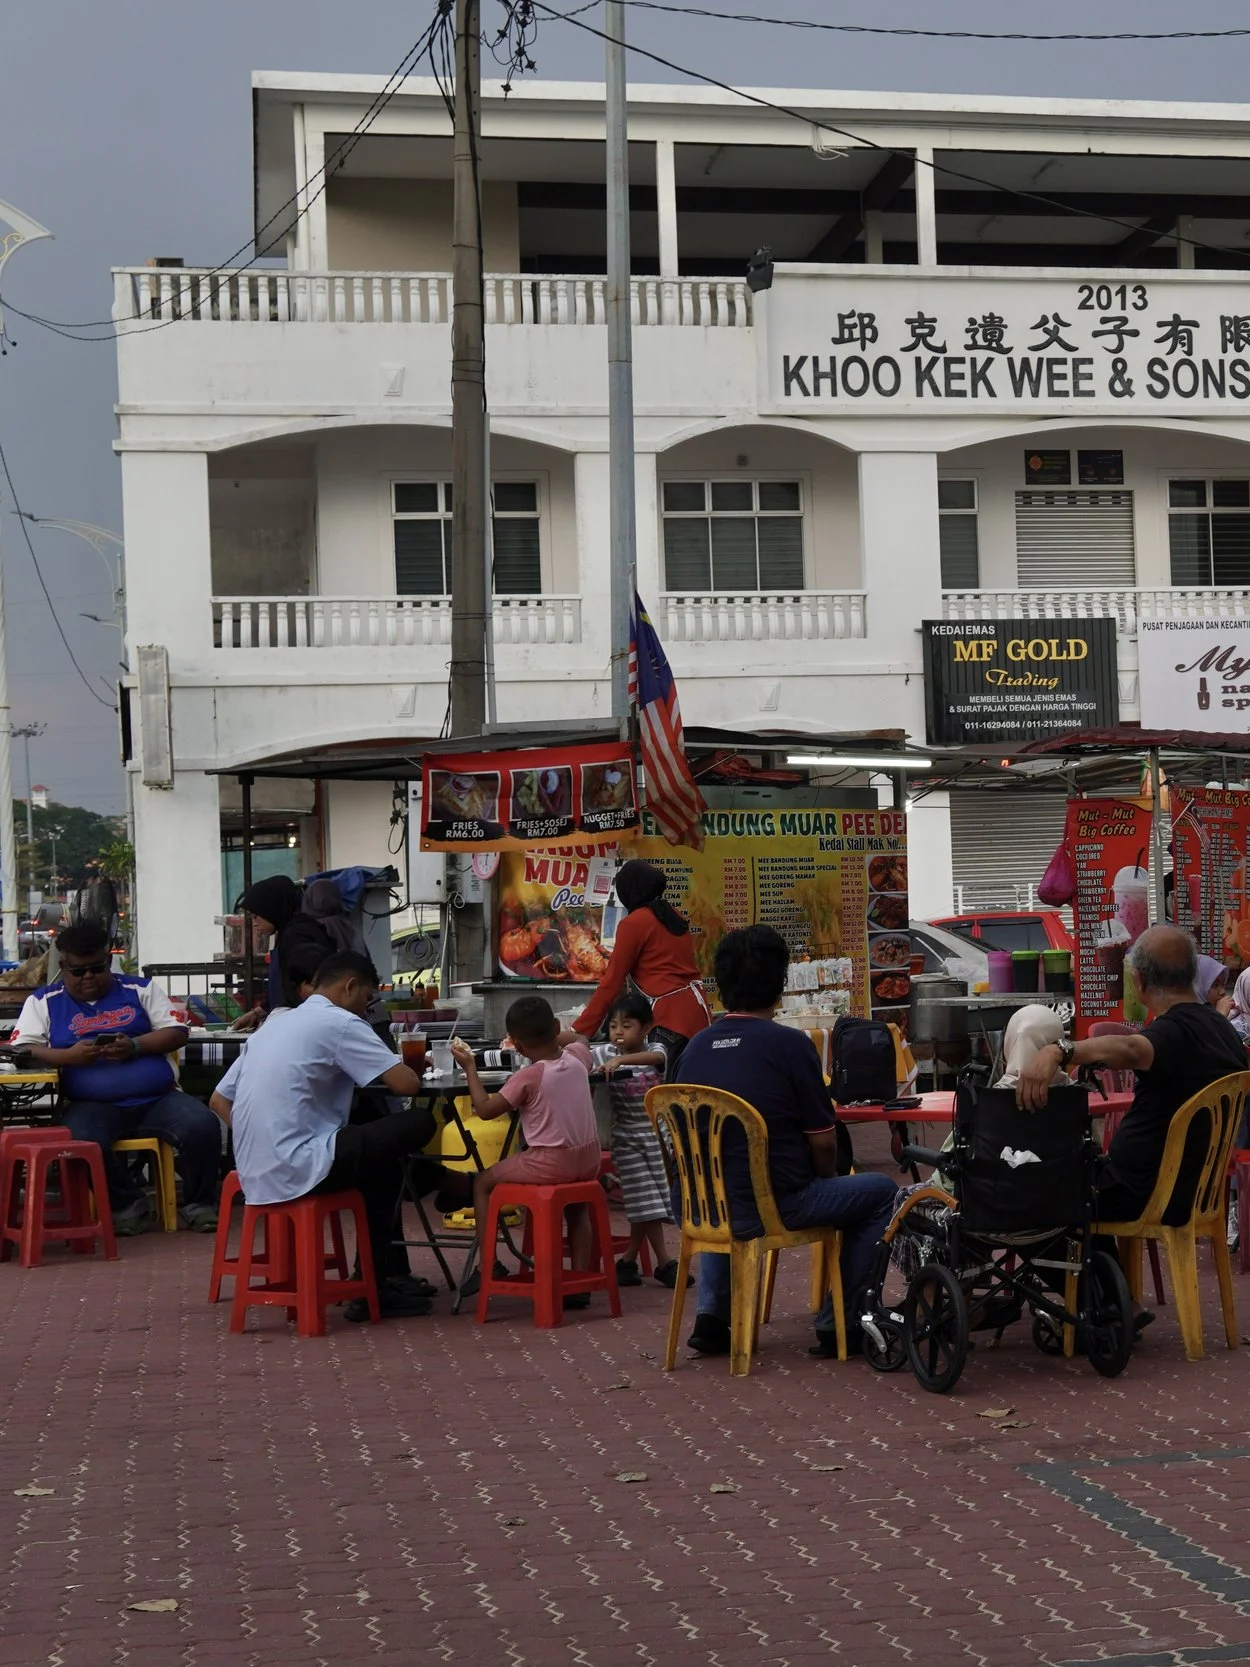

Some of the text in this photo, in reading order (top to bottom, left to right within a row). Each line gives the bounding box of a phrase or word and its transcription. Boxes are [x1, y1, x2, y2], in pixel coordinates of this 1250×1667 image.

[1077, 284, 1148, 312] 2013
[783, 355, 900, 398] KHOO
[914, 356, 995, 398] KEK
[1007, 356, 1096, 398] WEE
[1108, 357, 1136, 398] &
[932, 626, 996, 636] KEDAI EMAS
[1143, 622, 1163, 631] PUSAT
[1165, 621, 1204, 630] PENJAGAAN
[1206, 621, 1219, 629] DAN
[953, 638, 1088, 662] MF GOLD
[985, 668, 1059, 690] Trading
[970, 695, 1004, 703] MEMBELI
[1010, 704, 1041, 712] DENGAN
[964, 721, 1020, 730] 011-16294084
[1027, 720, 1082, 728] 011-21364084
[1205, 790, 1222, 803] Mut
[1225, 791, 1239, 807] Big
[584, 810, 635, 824] NUGGET+FRIES
[1078, 808, 1135, 822] Mut Mut
[453, 821, 479, 831] FRIES
[517, 818, 567, 829] FRIES+SOSEJ
[599, 820, 625, 830] RM7.50
[780, 813, 838, 836] MUAR
[842, 812, 876, 835] PEE
[880, 812, 907, 835] DE
[445, 829, 484, 838] RM6.00
[527, 827, 558, 837] RM7.00
[1079, 823, 1136, 839] Big Coffee
[819, 838, 844, 850] Kedai
[846, 838, 864, 850] Stall
[867, 838, 884, 850] Mak
